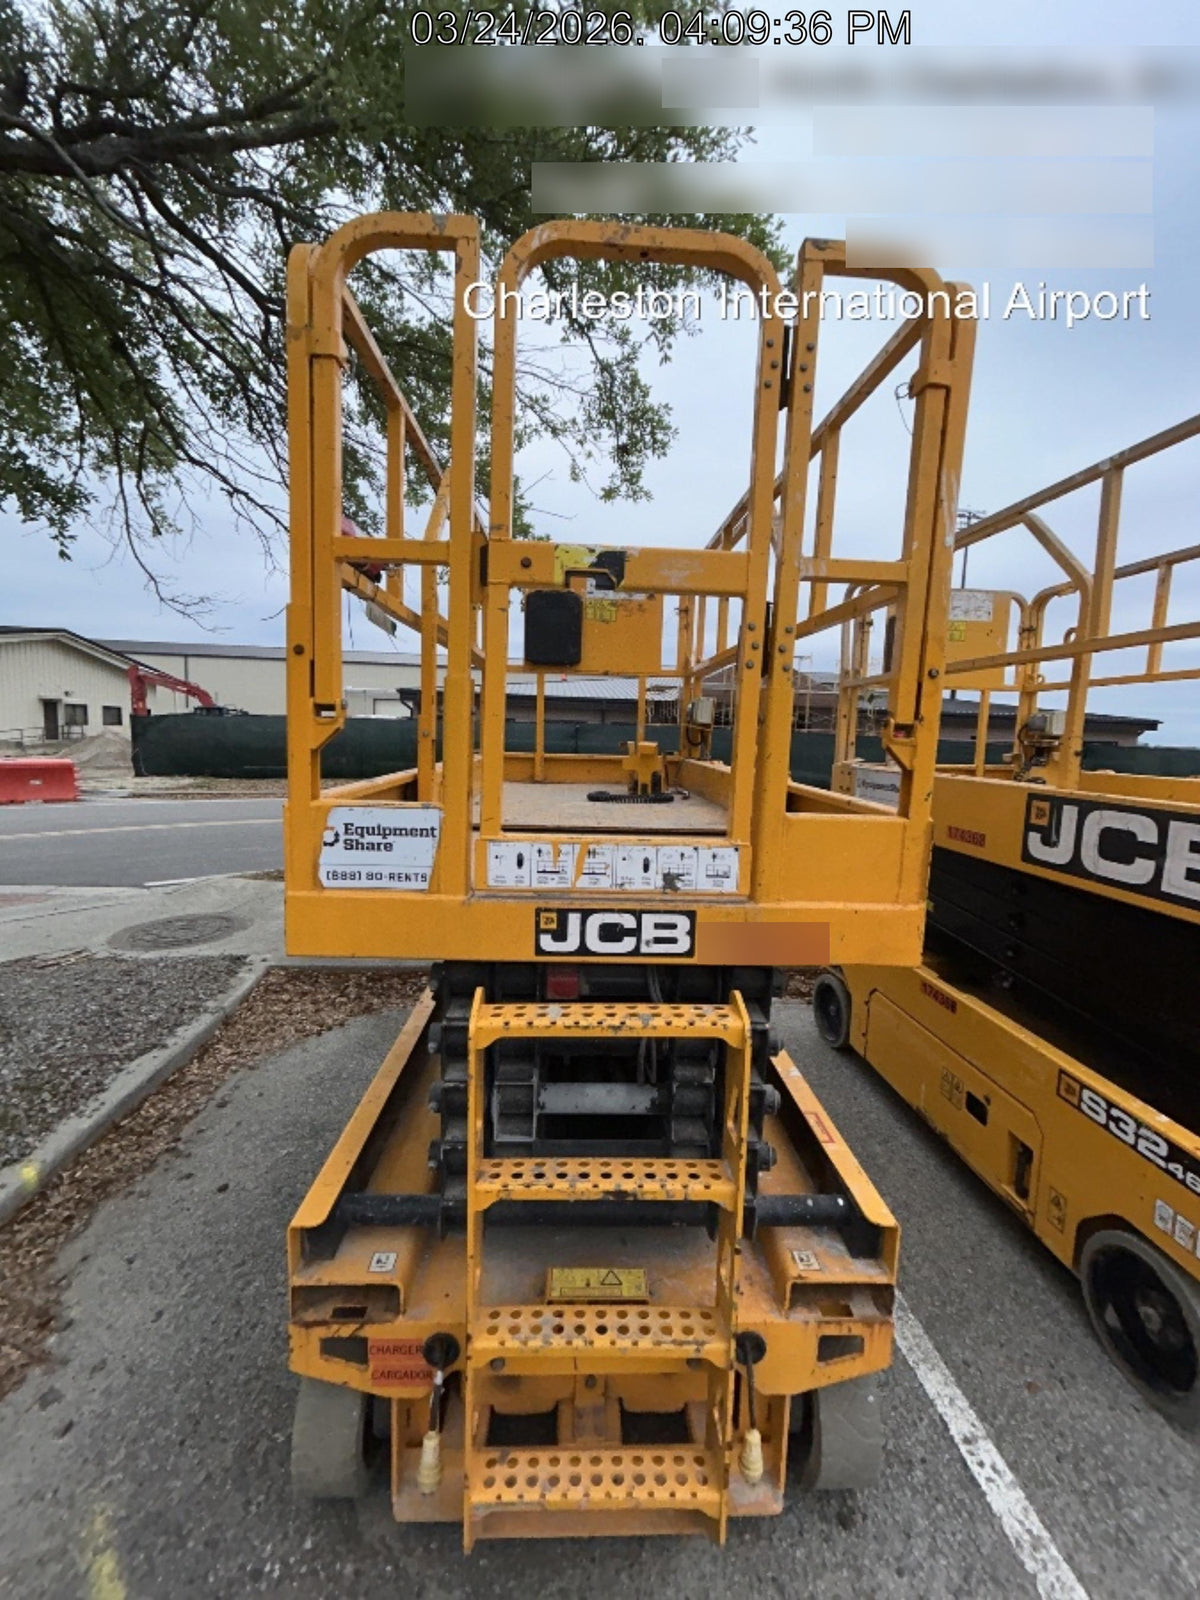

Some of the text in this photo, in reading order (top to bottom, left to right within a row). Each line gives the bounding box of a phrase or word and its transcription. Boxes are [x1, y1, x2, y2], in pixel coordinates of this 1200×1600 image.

[343, 822, 438, 840] Equipment
[343, 838, 394, 852] Share
[539, 911, 692, 954] JCB
[369, 1344, 424, 1356] CHARGER
[372, 1369, 433, 1381] CARGADOR
